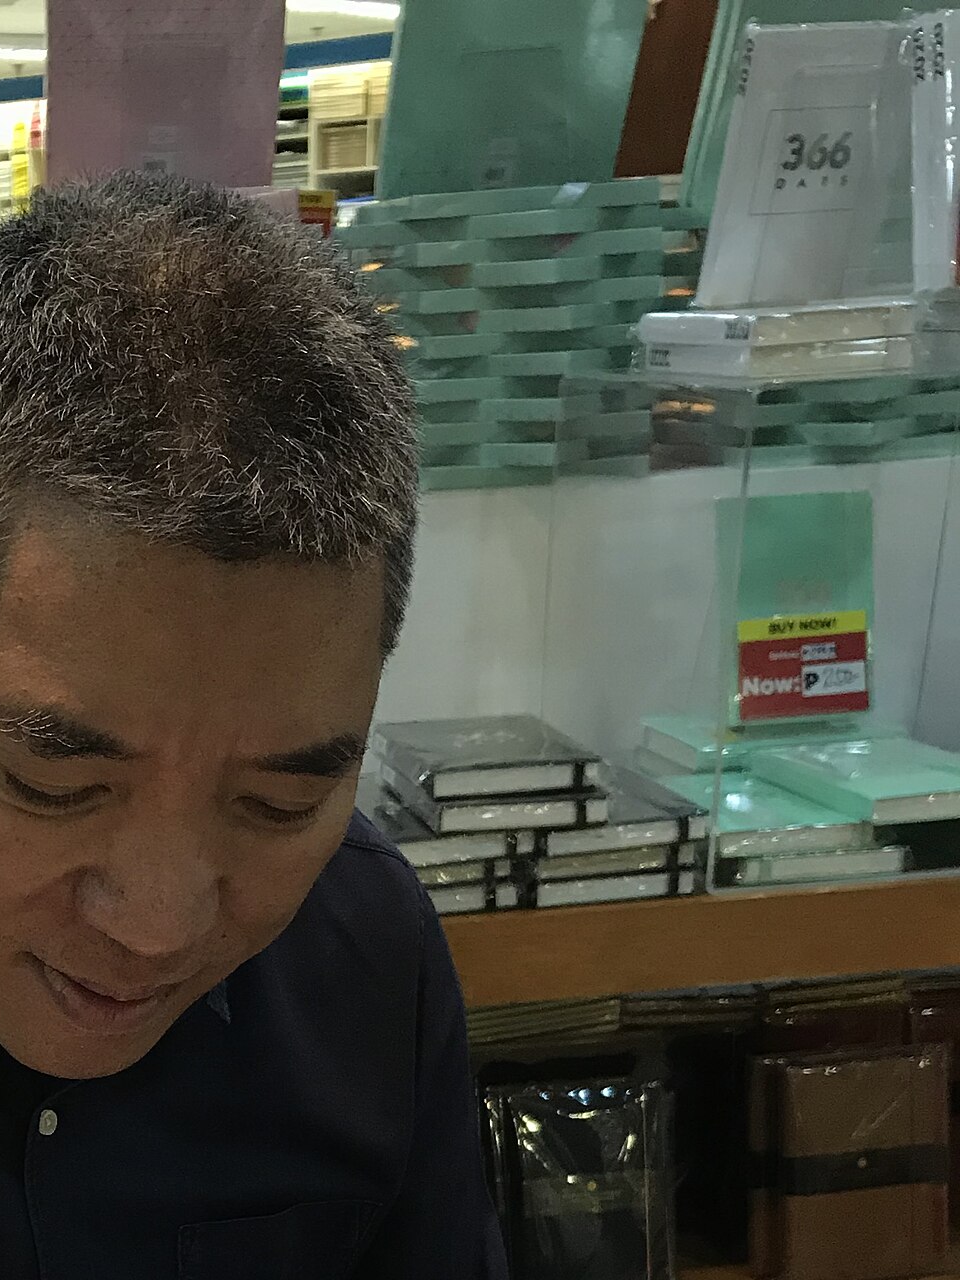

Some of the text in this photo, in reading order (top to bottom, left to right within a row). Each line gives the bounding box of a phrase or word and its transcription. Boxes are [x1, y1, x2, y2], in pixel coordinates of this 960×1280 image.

[780, 131, 853, 171] 366
[768, 617, 837, 635] BUY NOW!
[742, 674, 801, 698] Now:
